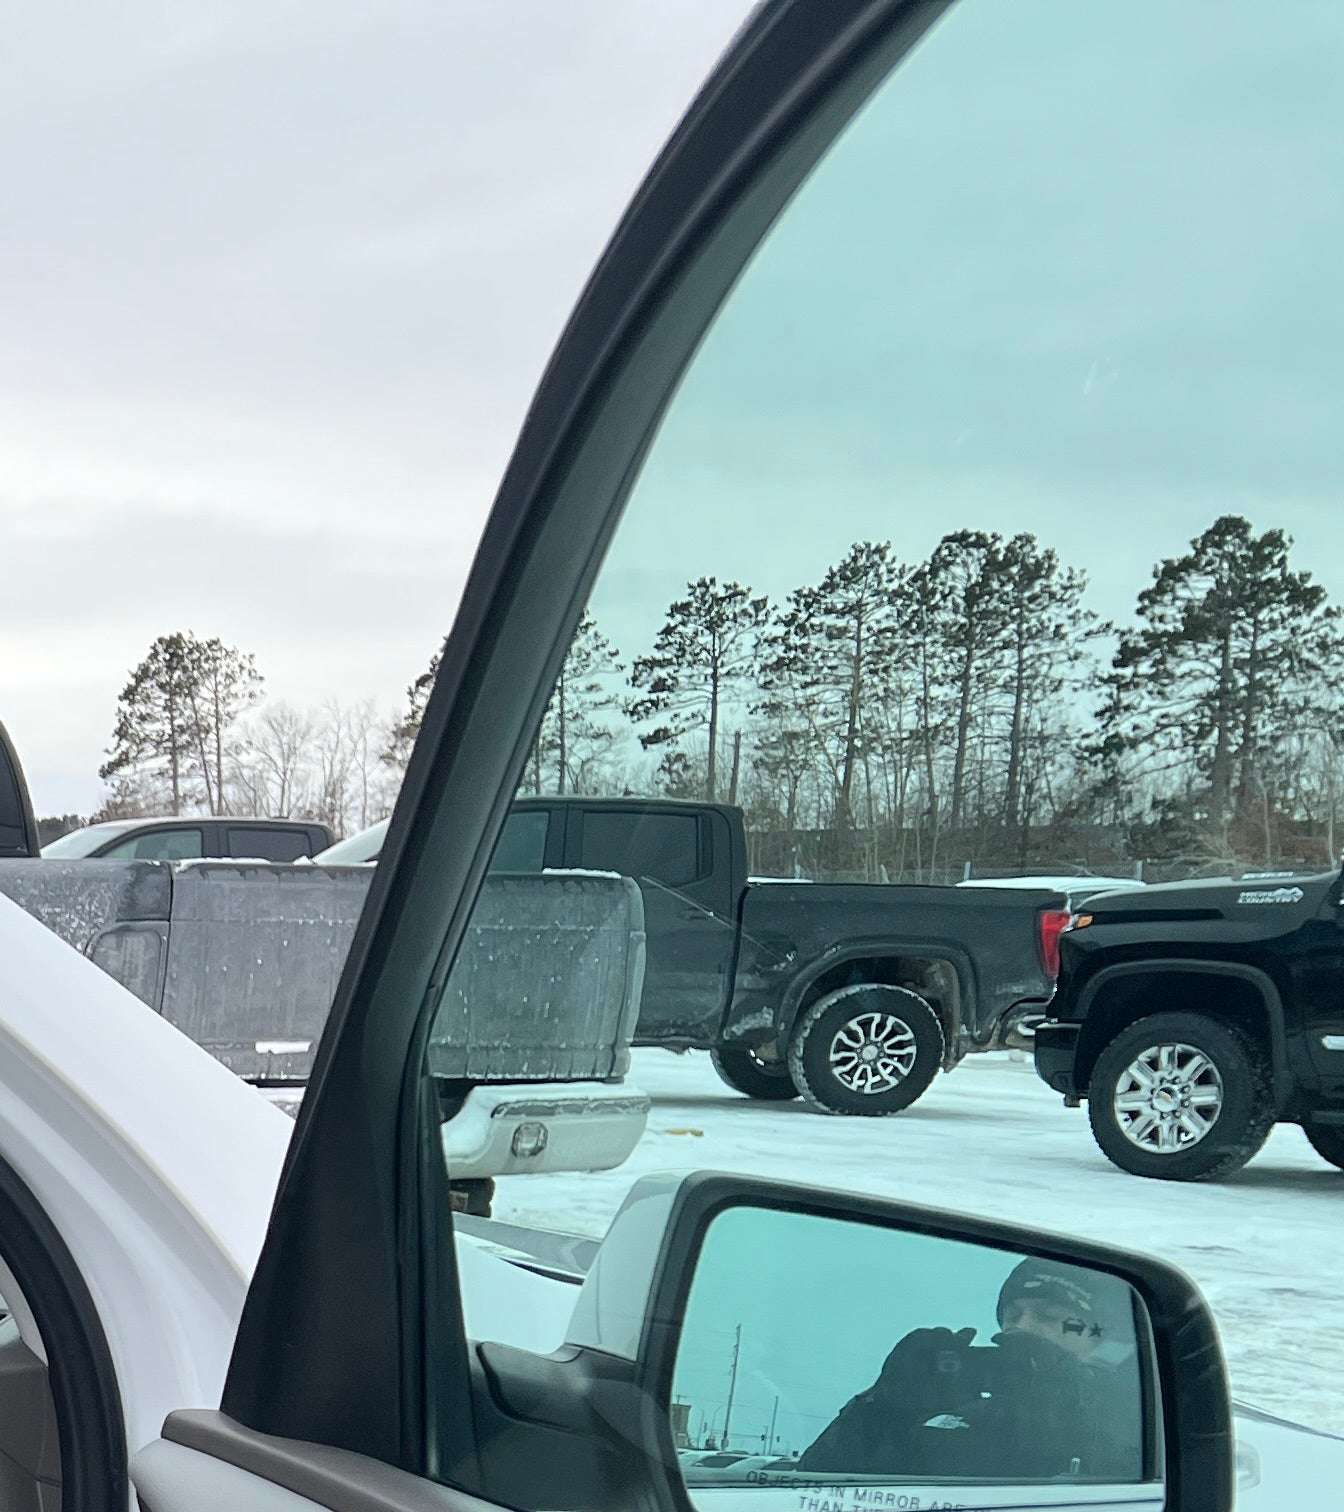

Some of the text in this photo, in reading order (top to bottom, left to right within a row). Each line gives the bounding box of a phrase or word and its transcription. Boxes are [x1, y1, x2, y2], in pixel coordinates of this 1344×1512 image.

[746, 1470, 822, 1494] OBJECTS
[829, 1486, 844, 1498] IN
[854, 1488, 920, 1510] MIRROR
